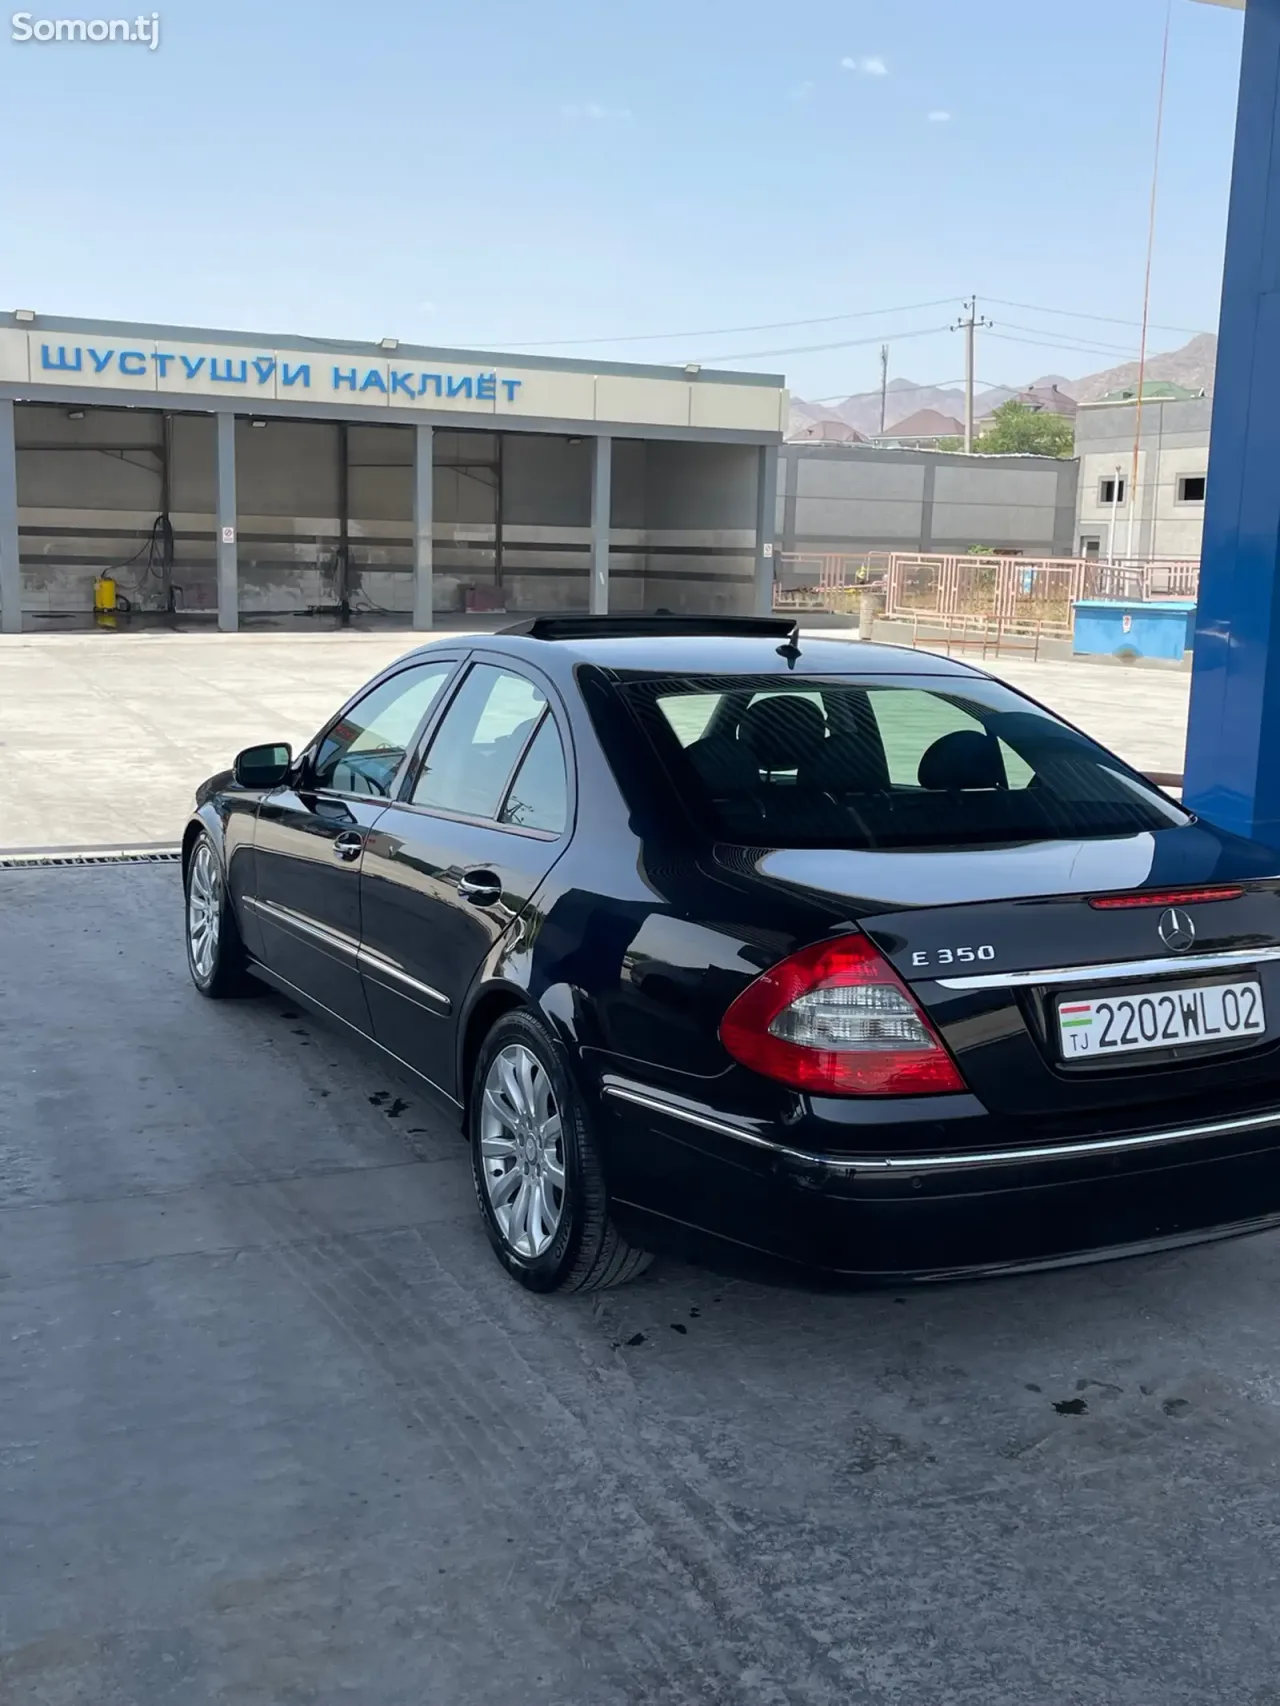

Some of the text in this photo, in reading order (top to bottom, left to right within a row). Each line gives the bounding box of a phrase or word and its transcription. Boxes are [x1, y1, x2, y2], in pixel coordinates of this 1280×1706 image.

[333, 365, 522, 402] НАҚЛИЁТ
[912, 945, 996, 966] E 350
[1070, 1032, 1089, 1051] TJ
